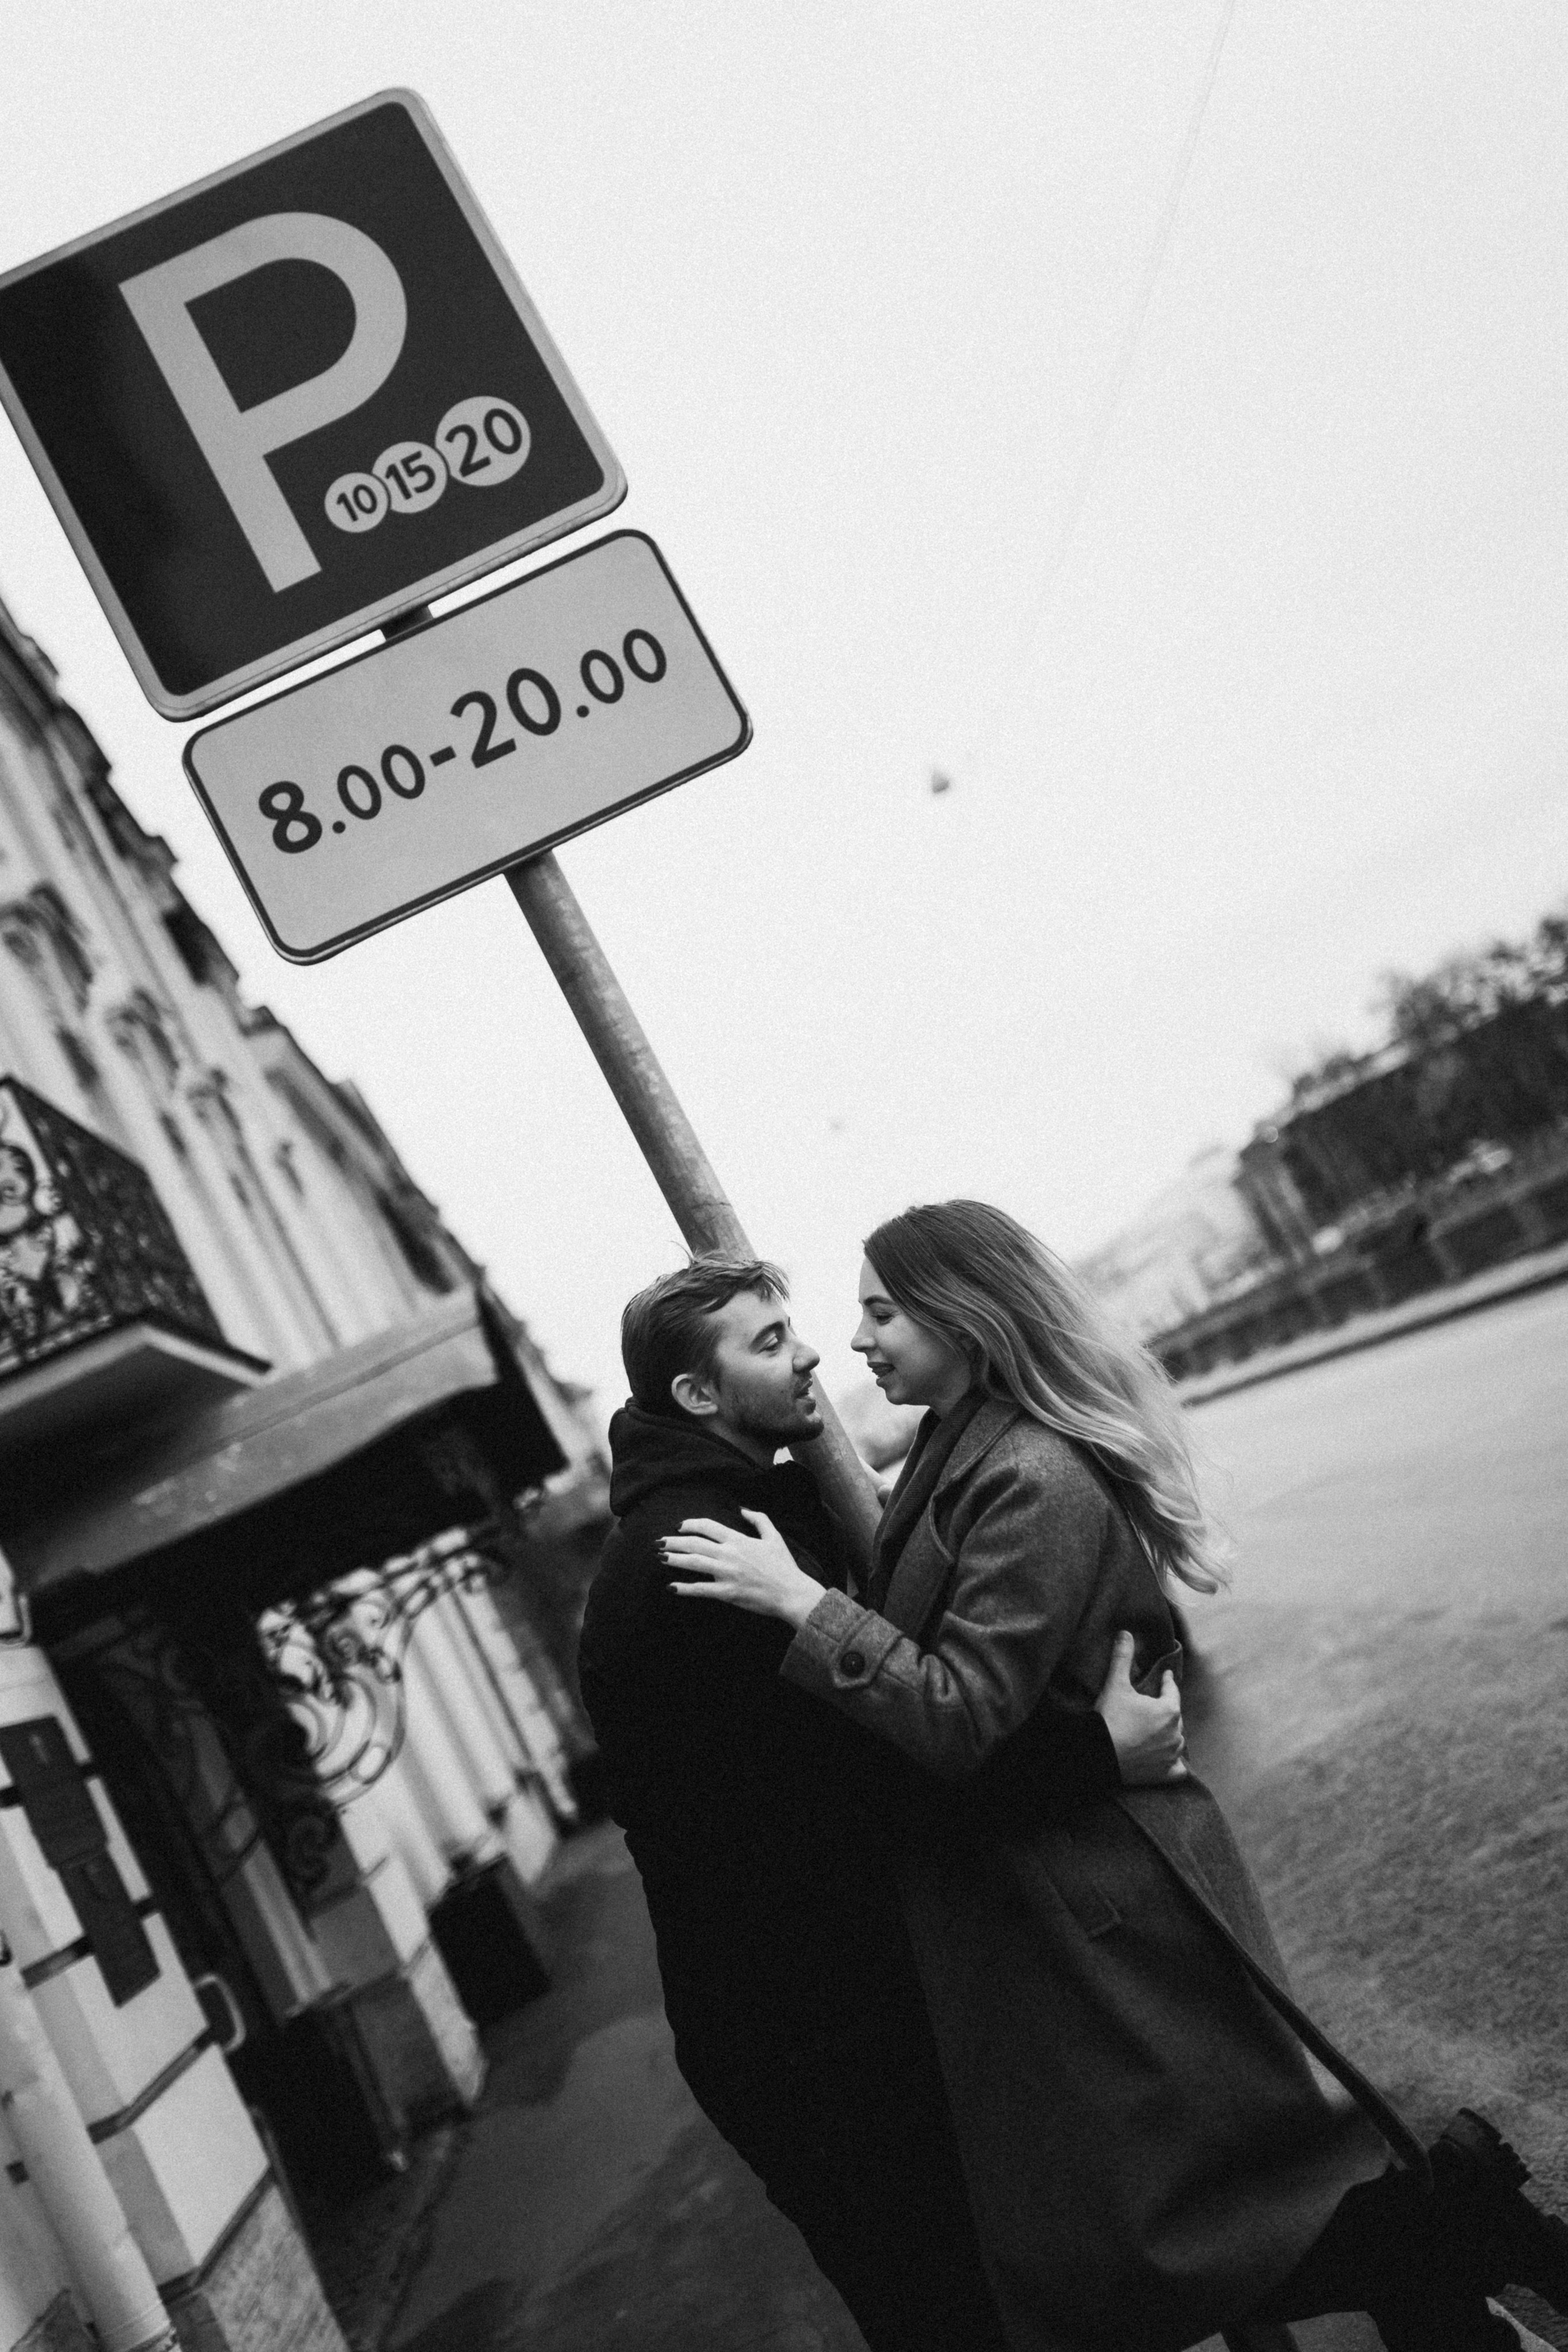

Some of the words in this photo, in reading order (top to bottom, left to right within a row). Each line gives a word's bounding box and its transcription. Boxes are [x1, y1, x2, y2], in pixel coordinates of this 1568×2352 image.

[119, 211, 407, 593] P
[336, 484, 377, 522] 10
[385, 451, 436, 500] 15
[445, 408, 522, 477] 20
[258, 628, 668, 854] 8.00-20.00
